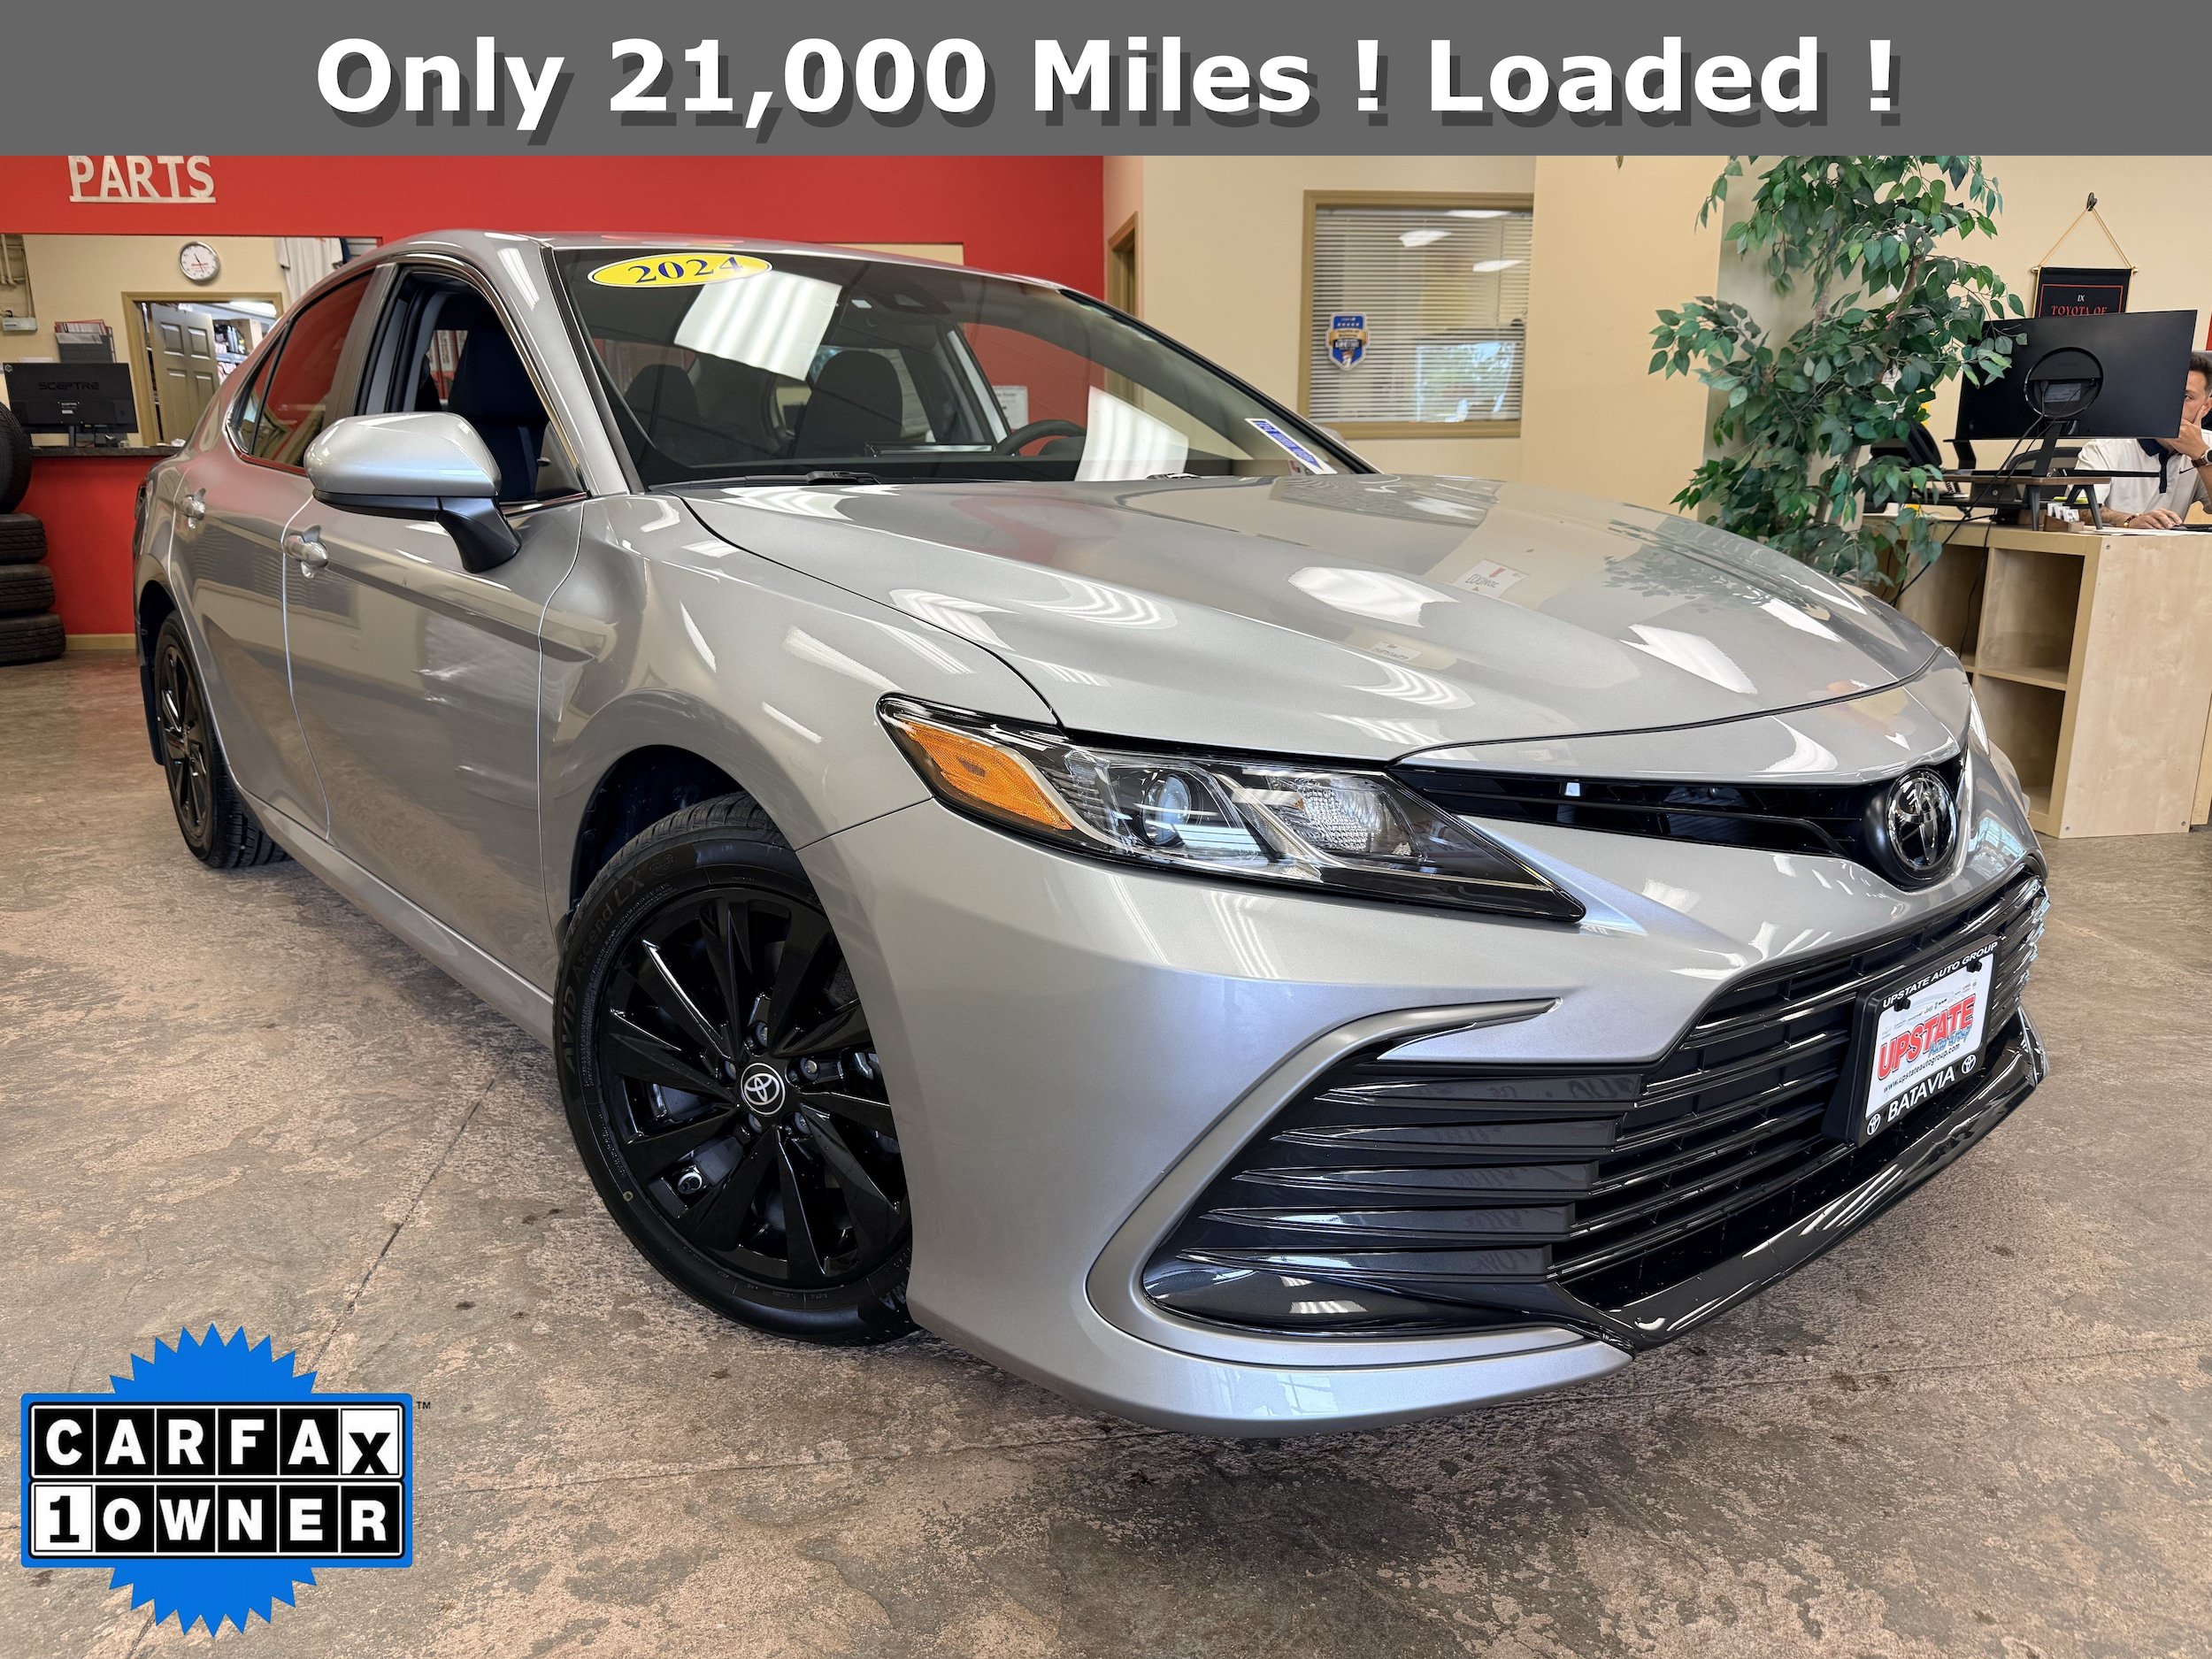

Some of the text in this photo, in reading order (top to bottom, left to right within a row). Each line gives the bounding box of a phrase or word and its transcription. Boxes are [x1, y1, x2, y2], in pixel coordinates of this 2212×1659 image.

[68, 156, 215, 201] PARTS
[627, 256, 744, 283] 2024
[2051, 305, 2089, 316] TOYOTA
[37, 381, 100, 390] SCEPTRE
[572, 905, 614, 976] Ascend
[1883, 974, 1931, 1009] UPSTATE
[1931, 960, 1961, 982] AUTO
[1962, 941, 1998, 966] GROUP
[1878, 993, 1977, 1080] UPSTATE
[1883, 1043, 1961, 1094] www.upstateautogroup.com
[1886, 1064, 1955, 1123] BATAVIA
